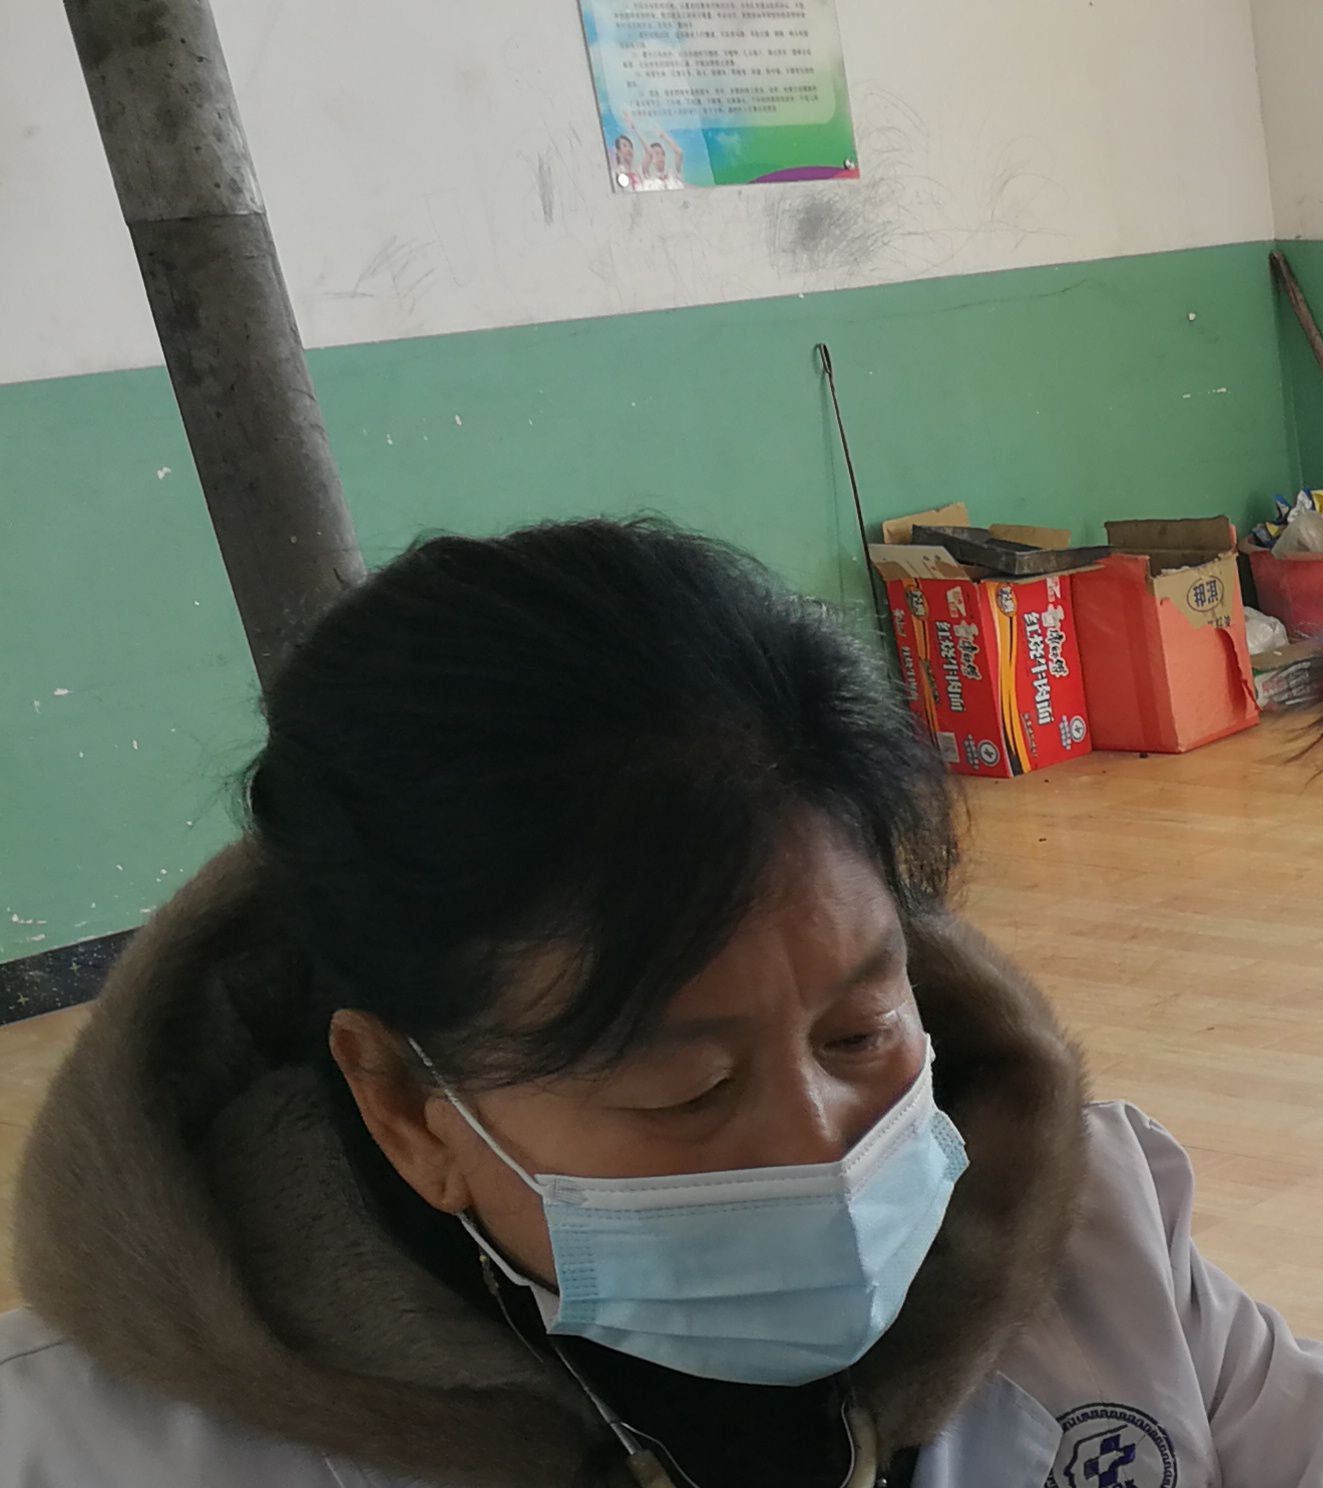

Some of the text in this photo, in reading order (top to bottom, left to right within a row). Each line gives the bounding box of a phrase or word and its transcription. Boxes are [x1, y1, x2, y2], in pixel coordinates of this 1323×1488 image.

[936, 621, 965, 711] 红烧牛肉面
[1024, 611, 1053, 724] 红烧牛肉面
